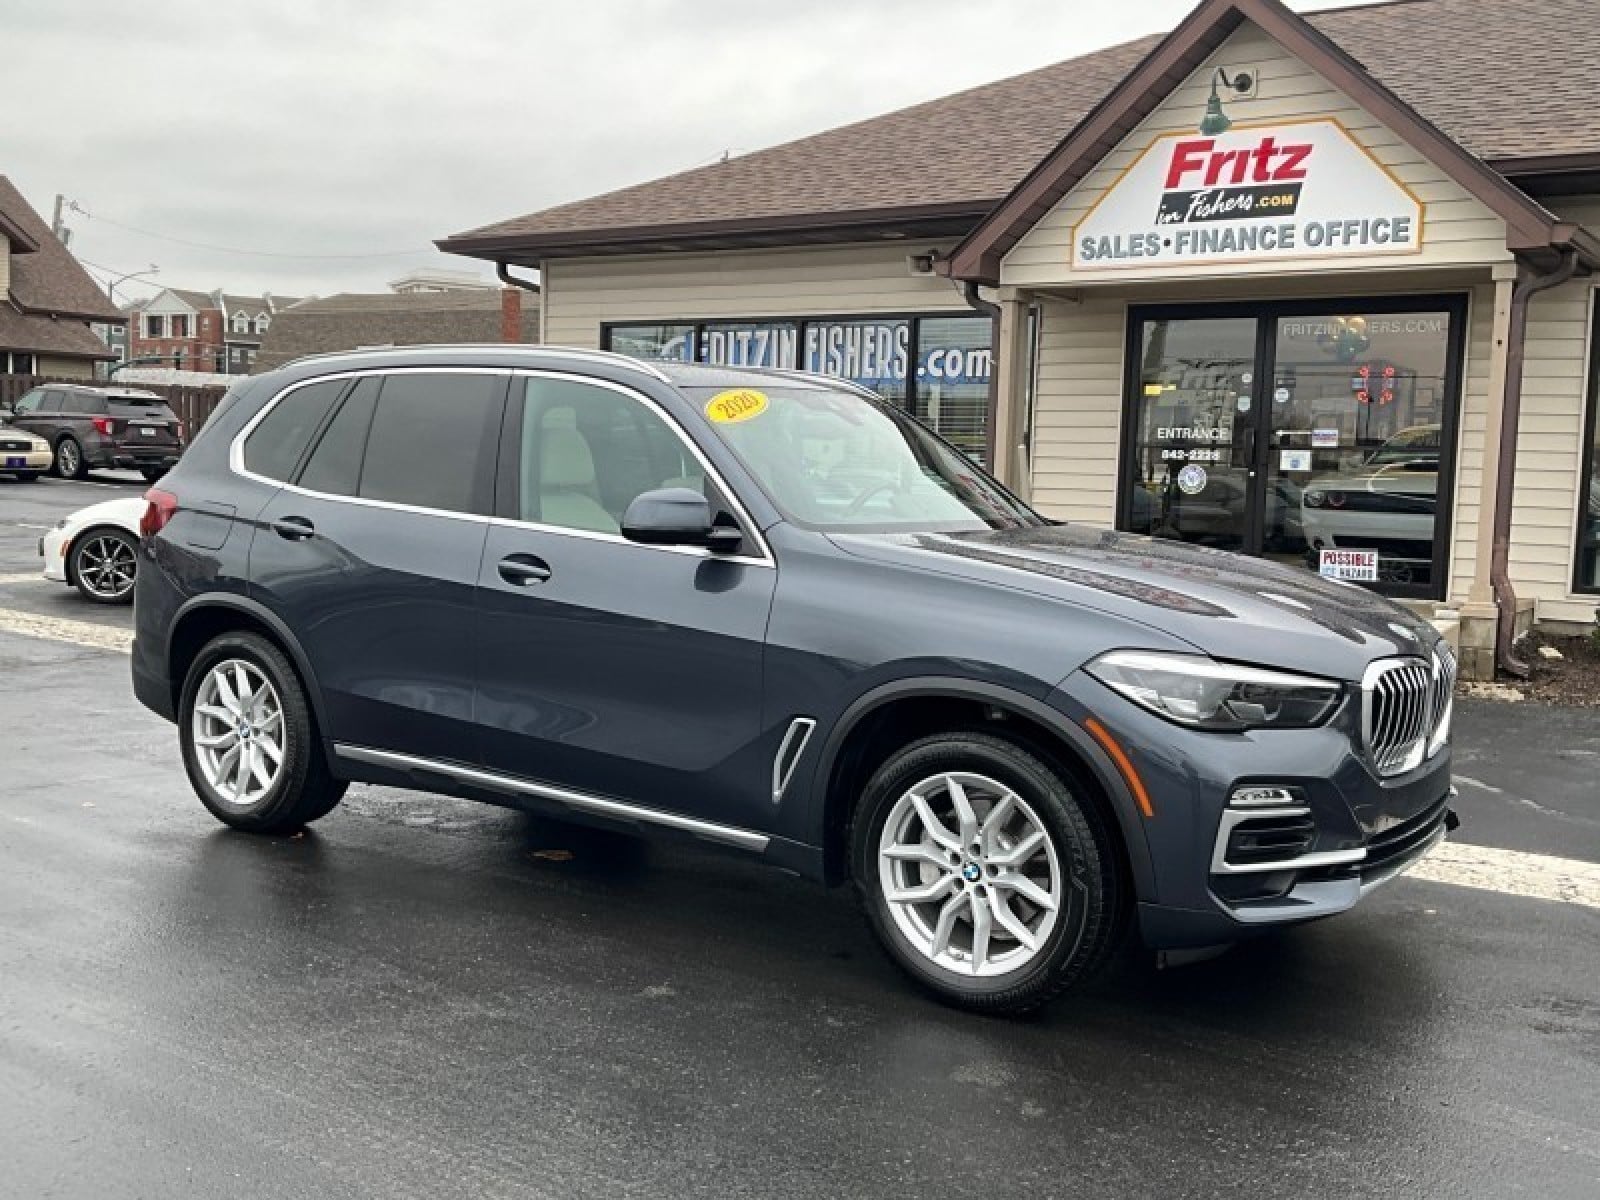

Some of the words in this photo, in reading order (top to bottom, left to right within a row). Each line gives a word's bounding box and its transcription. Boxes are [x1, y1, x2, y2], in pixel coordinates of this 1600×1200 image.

[1165, 136, 1314, 189] Fritz
[1159, 205, 1181, 224] in
[1184, 188, 1253, 224] Fishers
[1303, 217, 1411, 247] OFFICE
[717, 392, 759, 418] 2020
[1157, 427, 1228, 439] ENTRANCE
[1323, 552, 1375, 566] POSSIBLE
